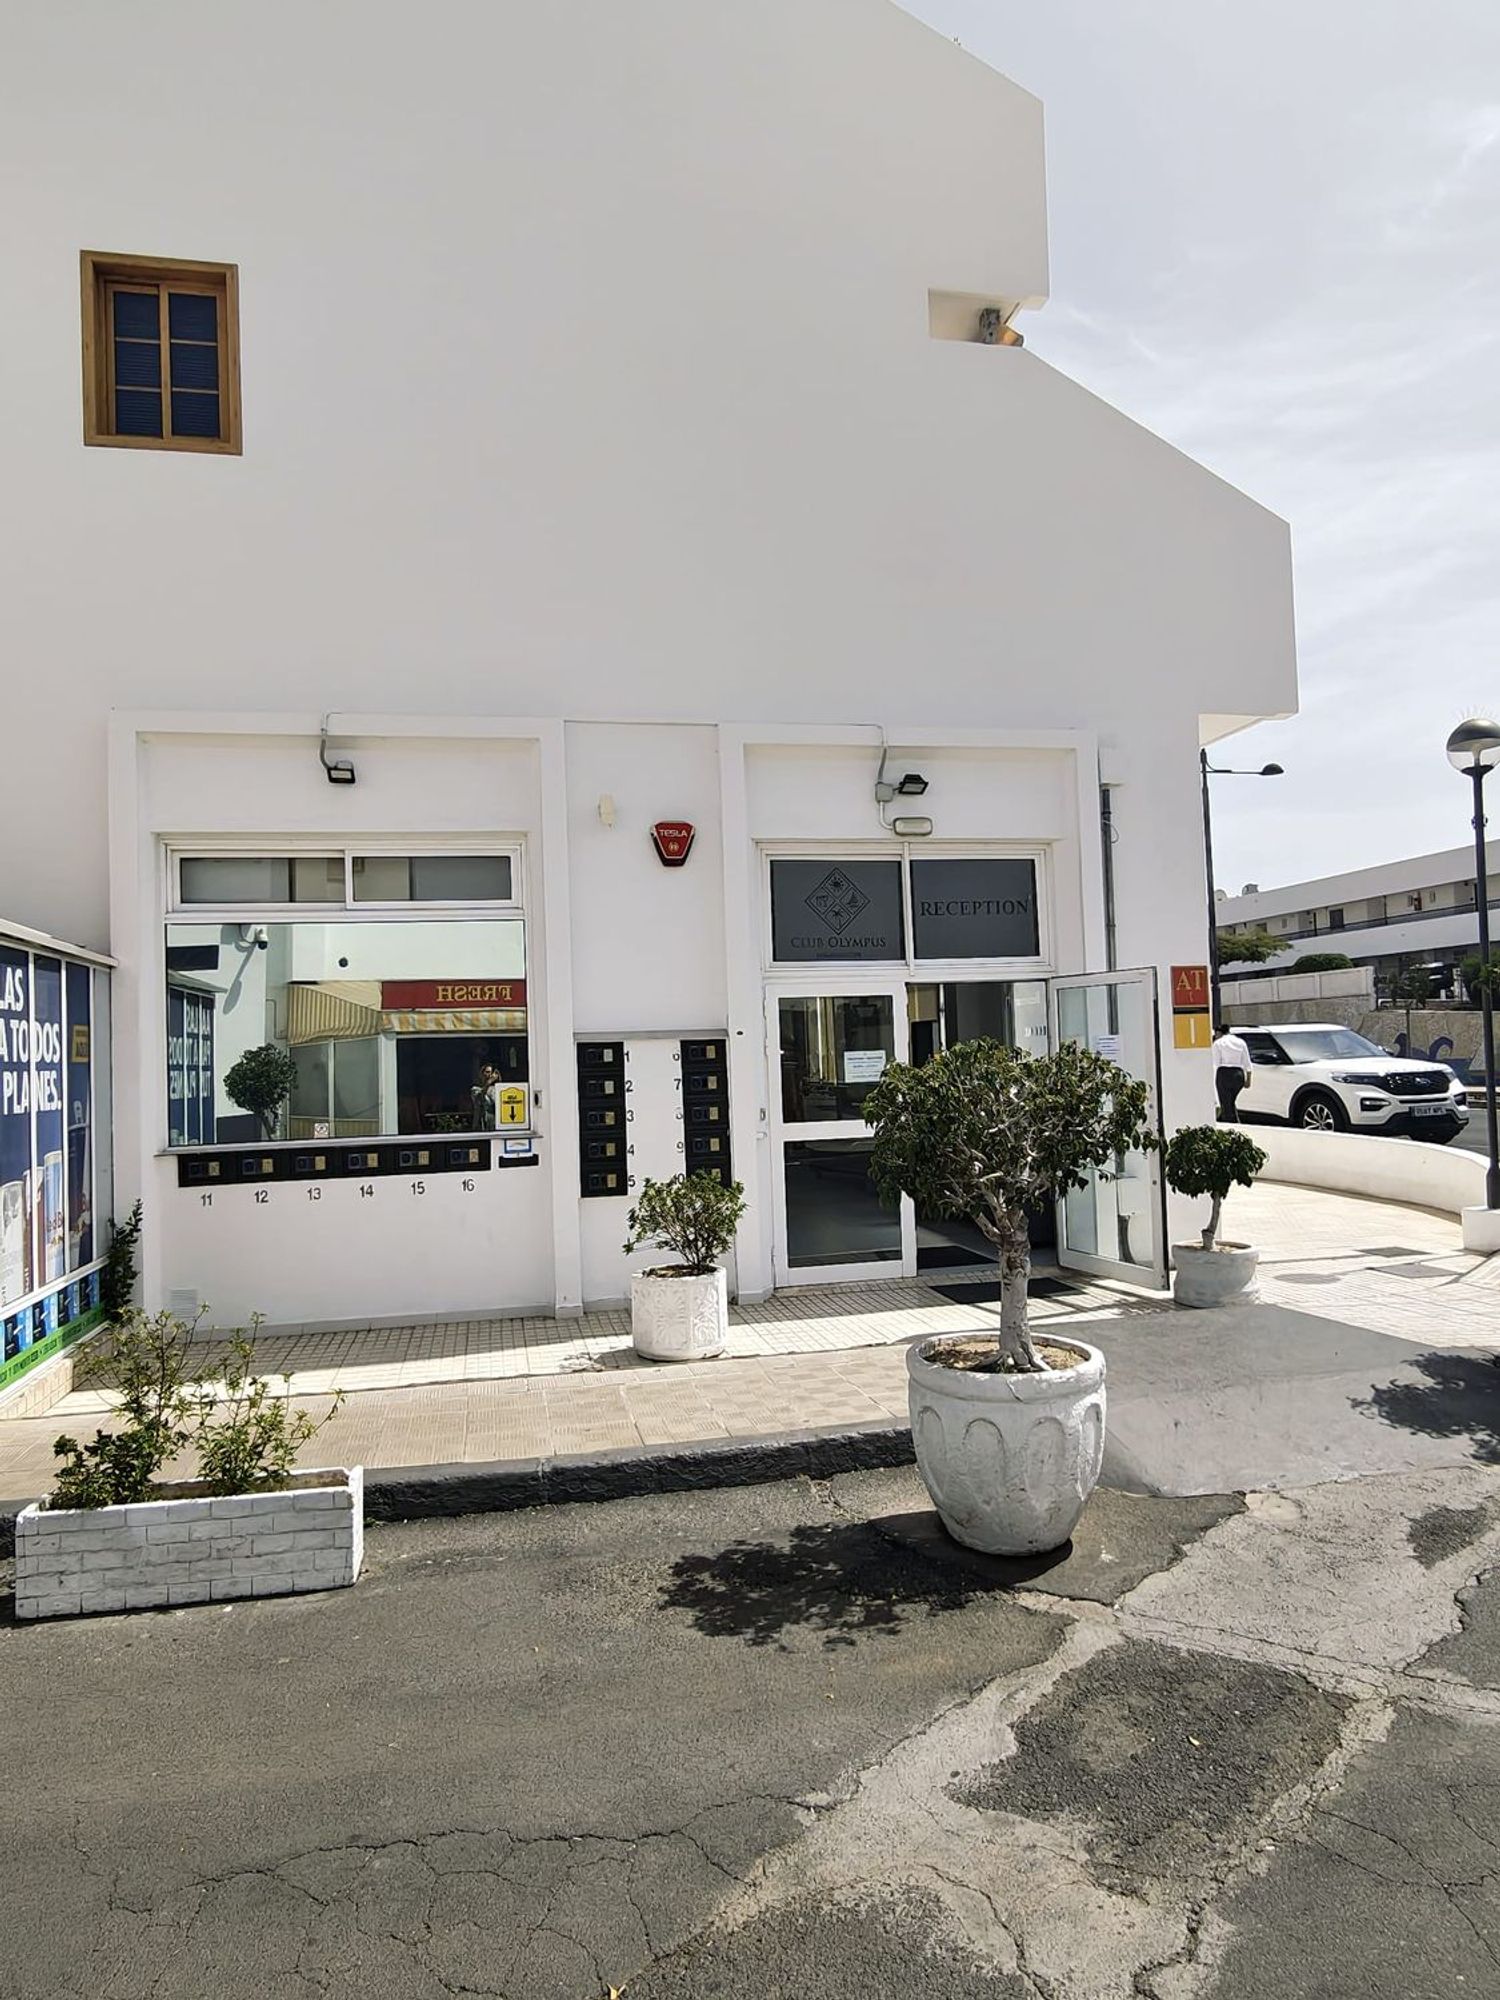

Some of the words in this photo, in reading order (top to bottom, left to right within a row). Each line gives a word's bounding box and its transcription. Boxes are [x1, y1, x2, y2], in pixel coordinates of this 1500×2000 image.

[658, 829, 688, 837] TESLA
[920, 900, 1028, 916] RECEPTION
[790, 937, 824, 948] CLUB
[828, 936, 887, 948] OLYMPUS
[1176, 970, 1204, 991] AT
[0, 966, 24, 1012] AS
[10, 1019, 61, 1064] TODOS
[625, 1080, 634, 1093] 2
[673, 1078, 682, 1090] 7
[3, 1070, 62, 1115] PLANES.
[626, 1109, 635, 1123] 3
[627, 1144, 635, 1156] 4
[676, 1141, 684, 1153] 9
[410, 1181, 425, 1195] 15
[462, 1179, 475, 1192] 16
[627, 1175, 636, 1188] 5
[254, 1190, 269, 1204] 12
[307, 1187, 322, 1200] 13
[359, 1184, 375, 1198] 14
[201, 1193, 213, 1206] 11
